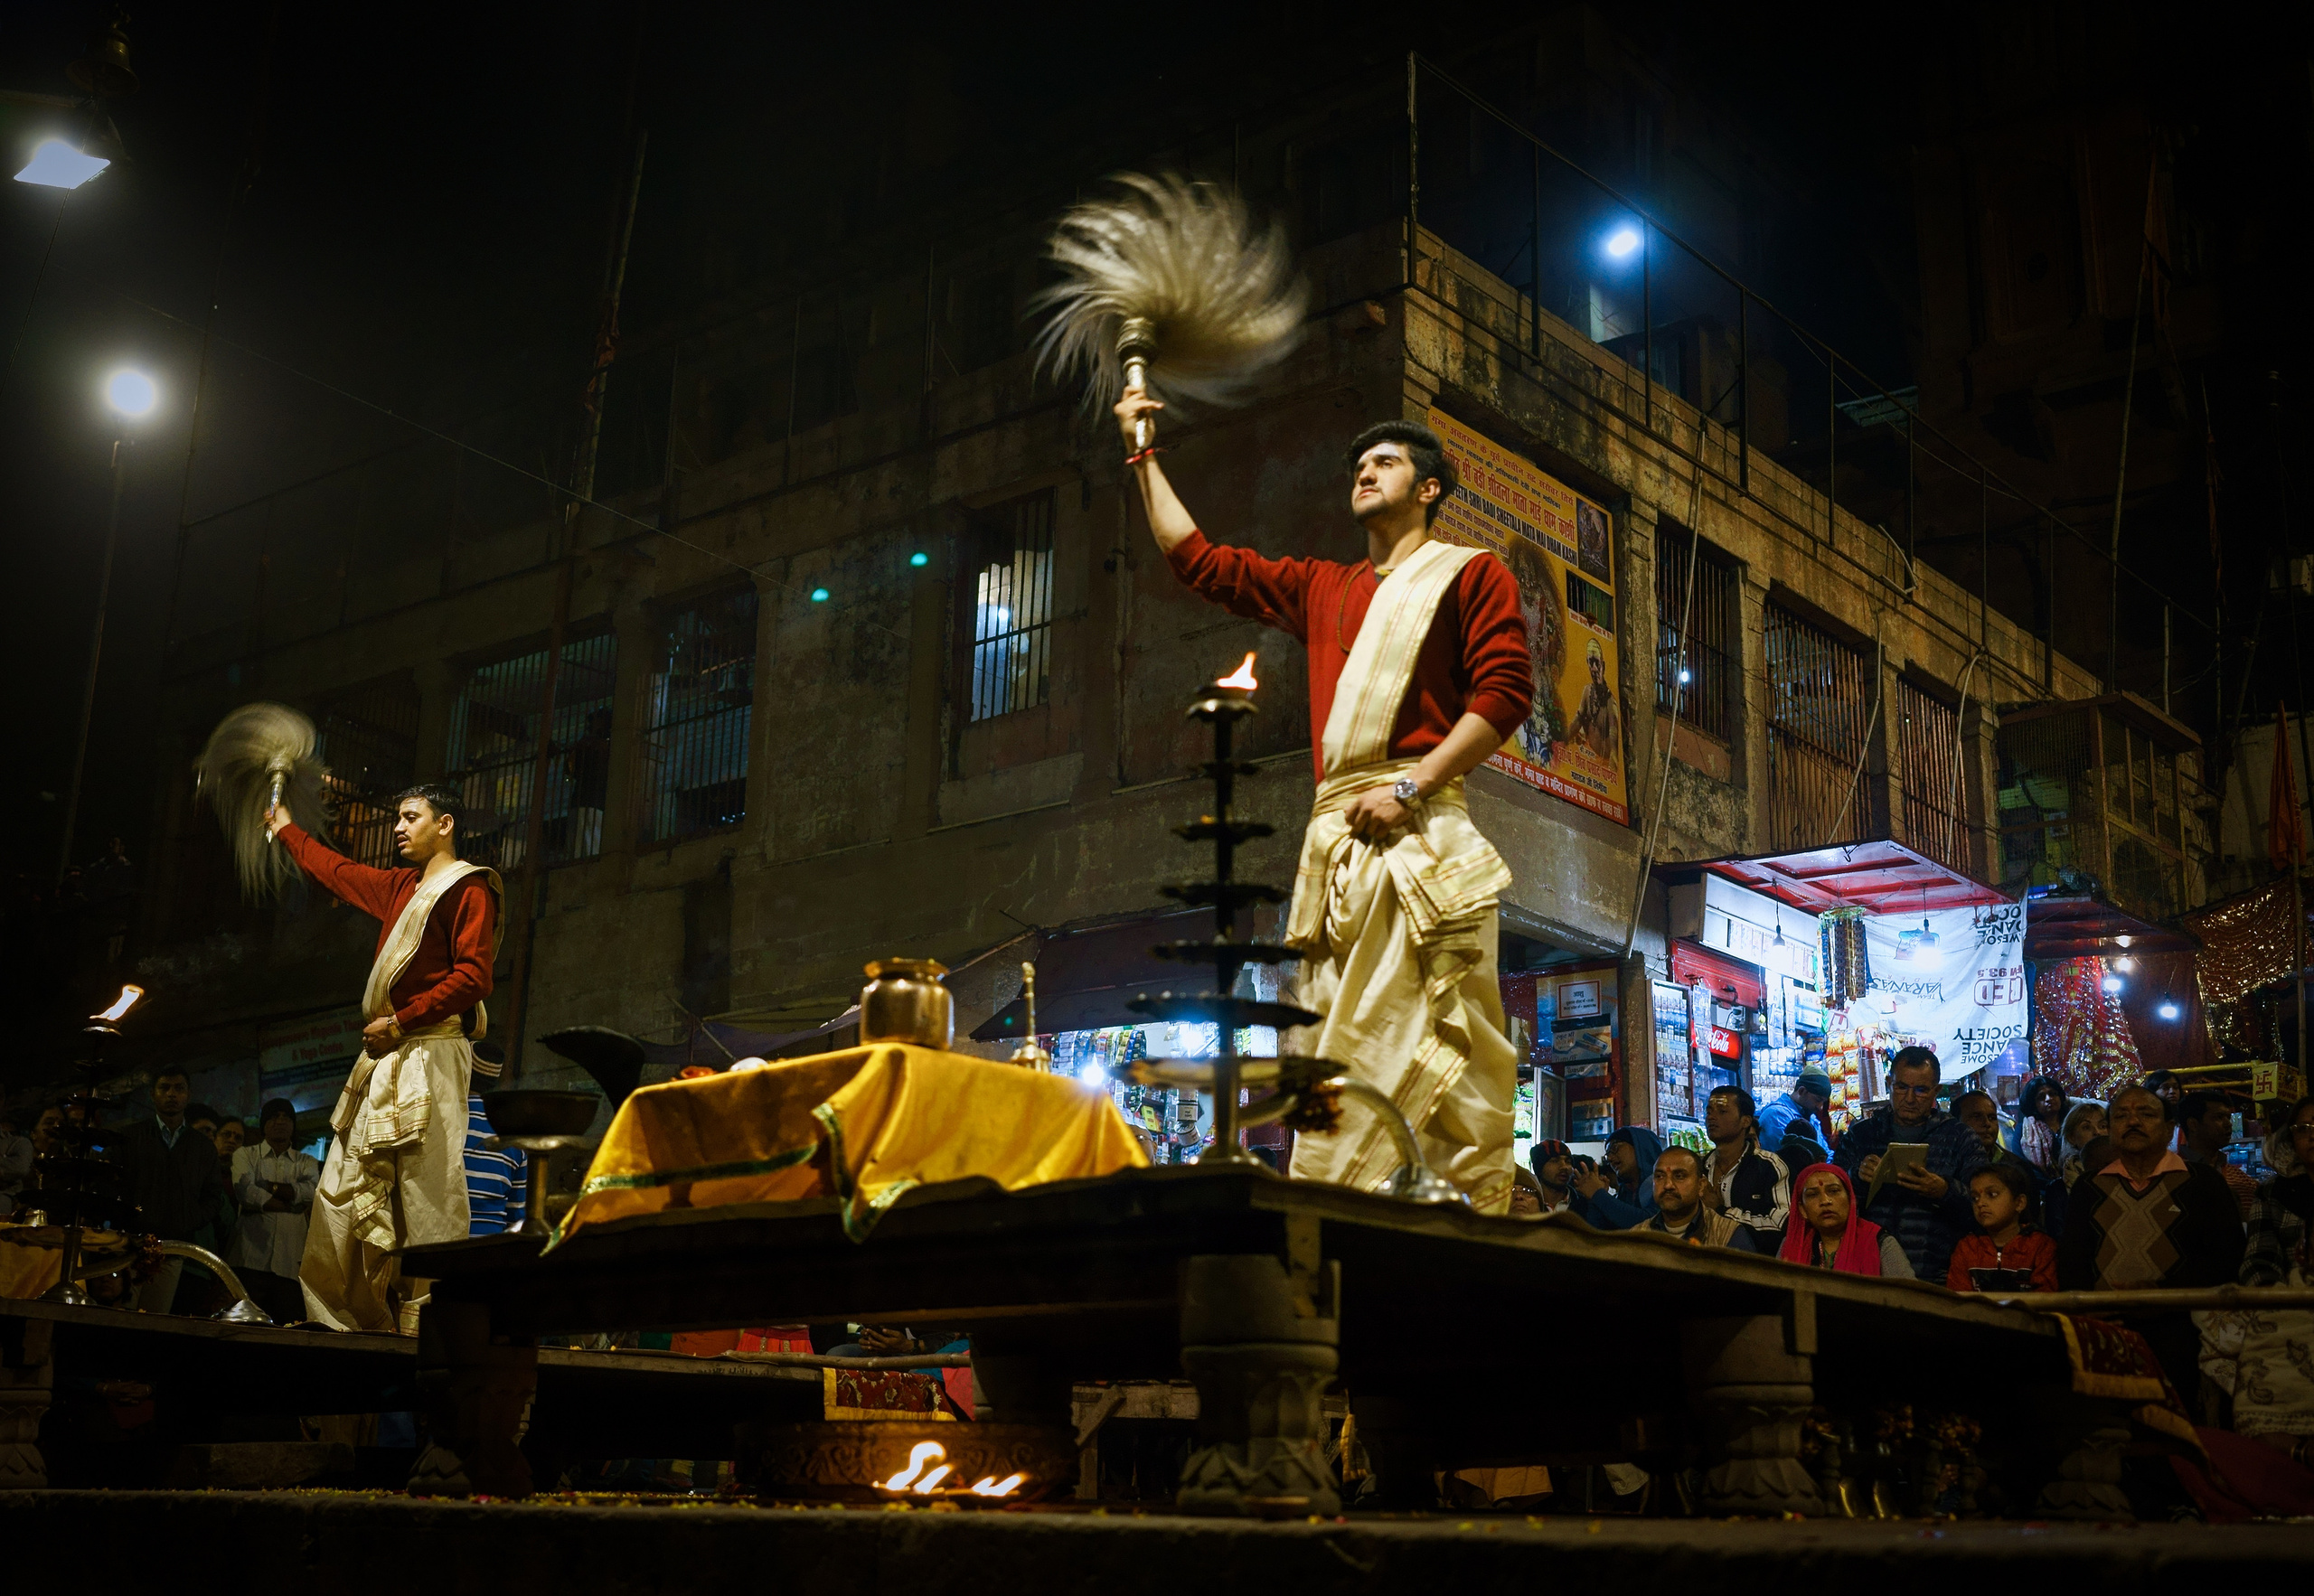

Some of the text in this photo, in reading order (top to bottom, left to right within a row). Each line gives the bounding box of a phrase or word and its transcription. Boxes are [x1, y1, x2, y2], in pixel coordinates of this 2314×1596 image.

[1463, 457, 1471, 482] श्री
[1488, 473, 1510, 505] शीतला
[1512, 490, 1528, 515] माता
[1558, 517, 1576, 542] काशी
[1977, 967, 2008, 978] 93.5
[1974, 976, 2023, 1006] RED
[1952, 1024, 2023, 1041] SOCIETY
[1961, 1039, 2009, 1055] ANCE
[1961, 1053, 2000, 1064] ESOME
